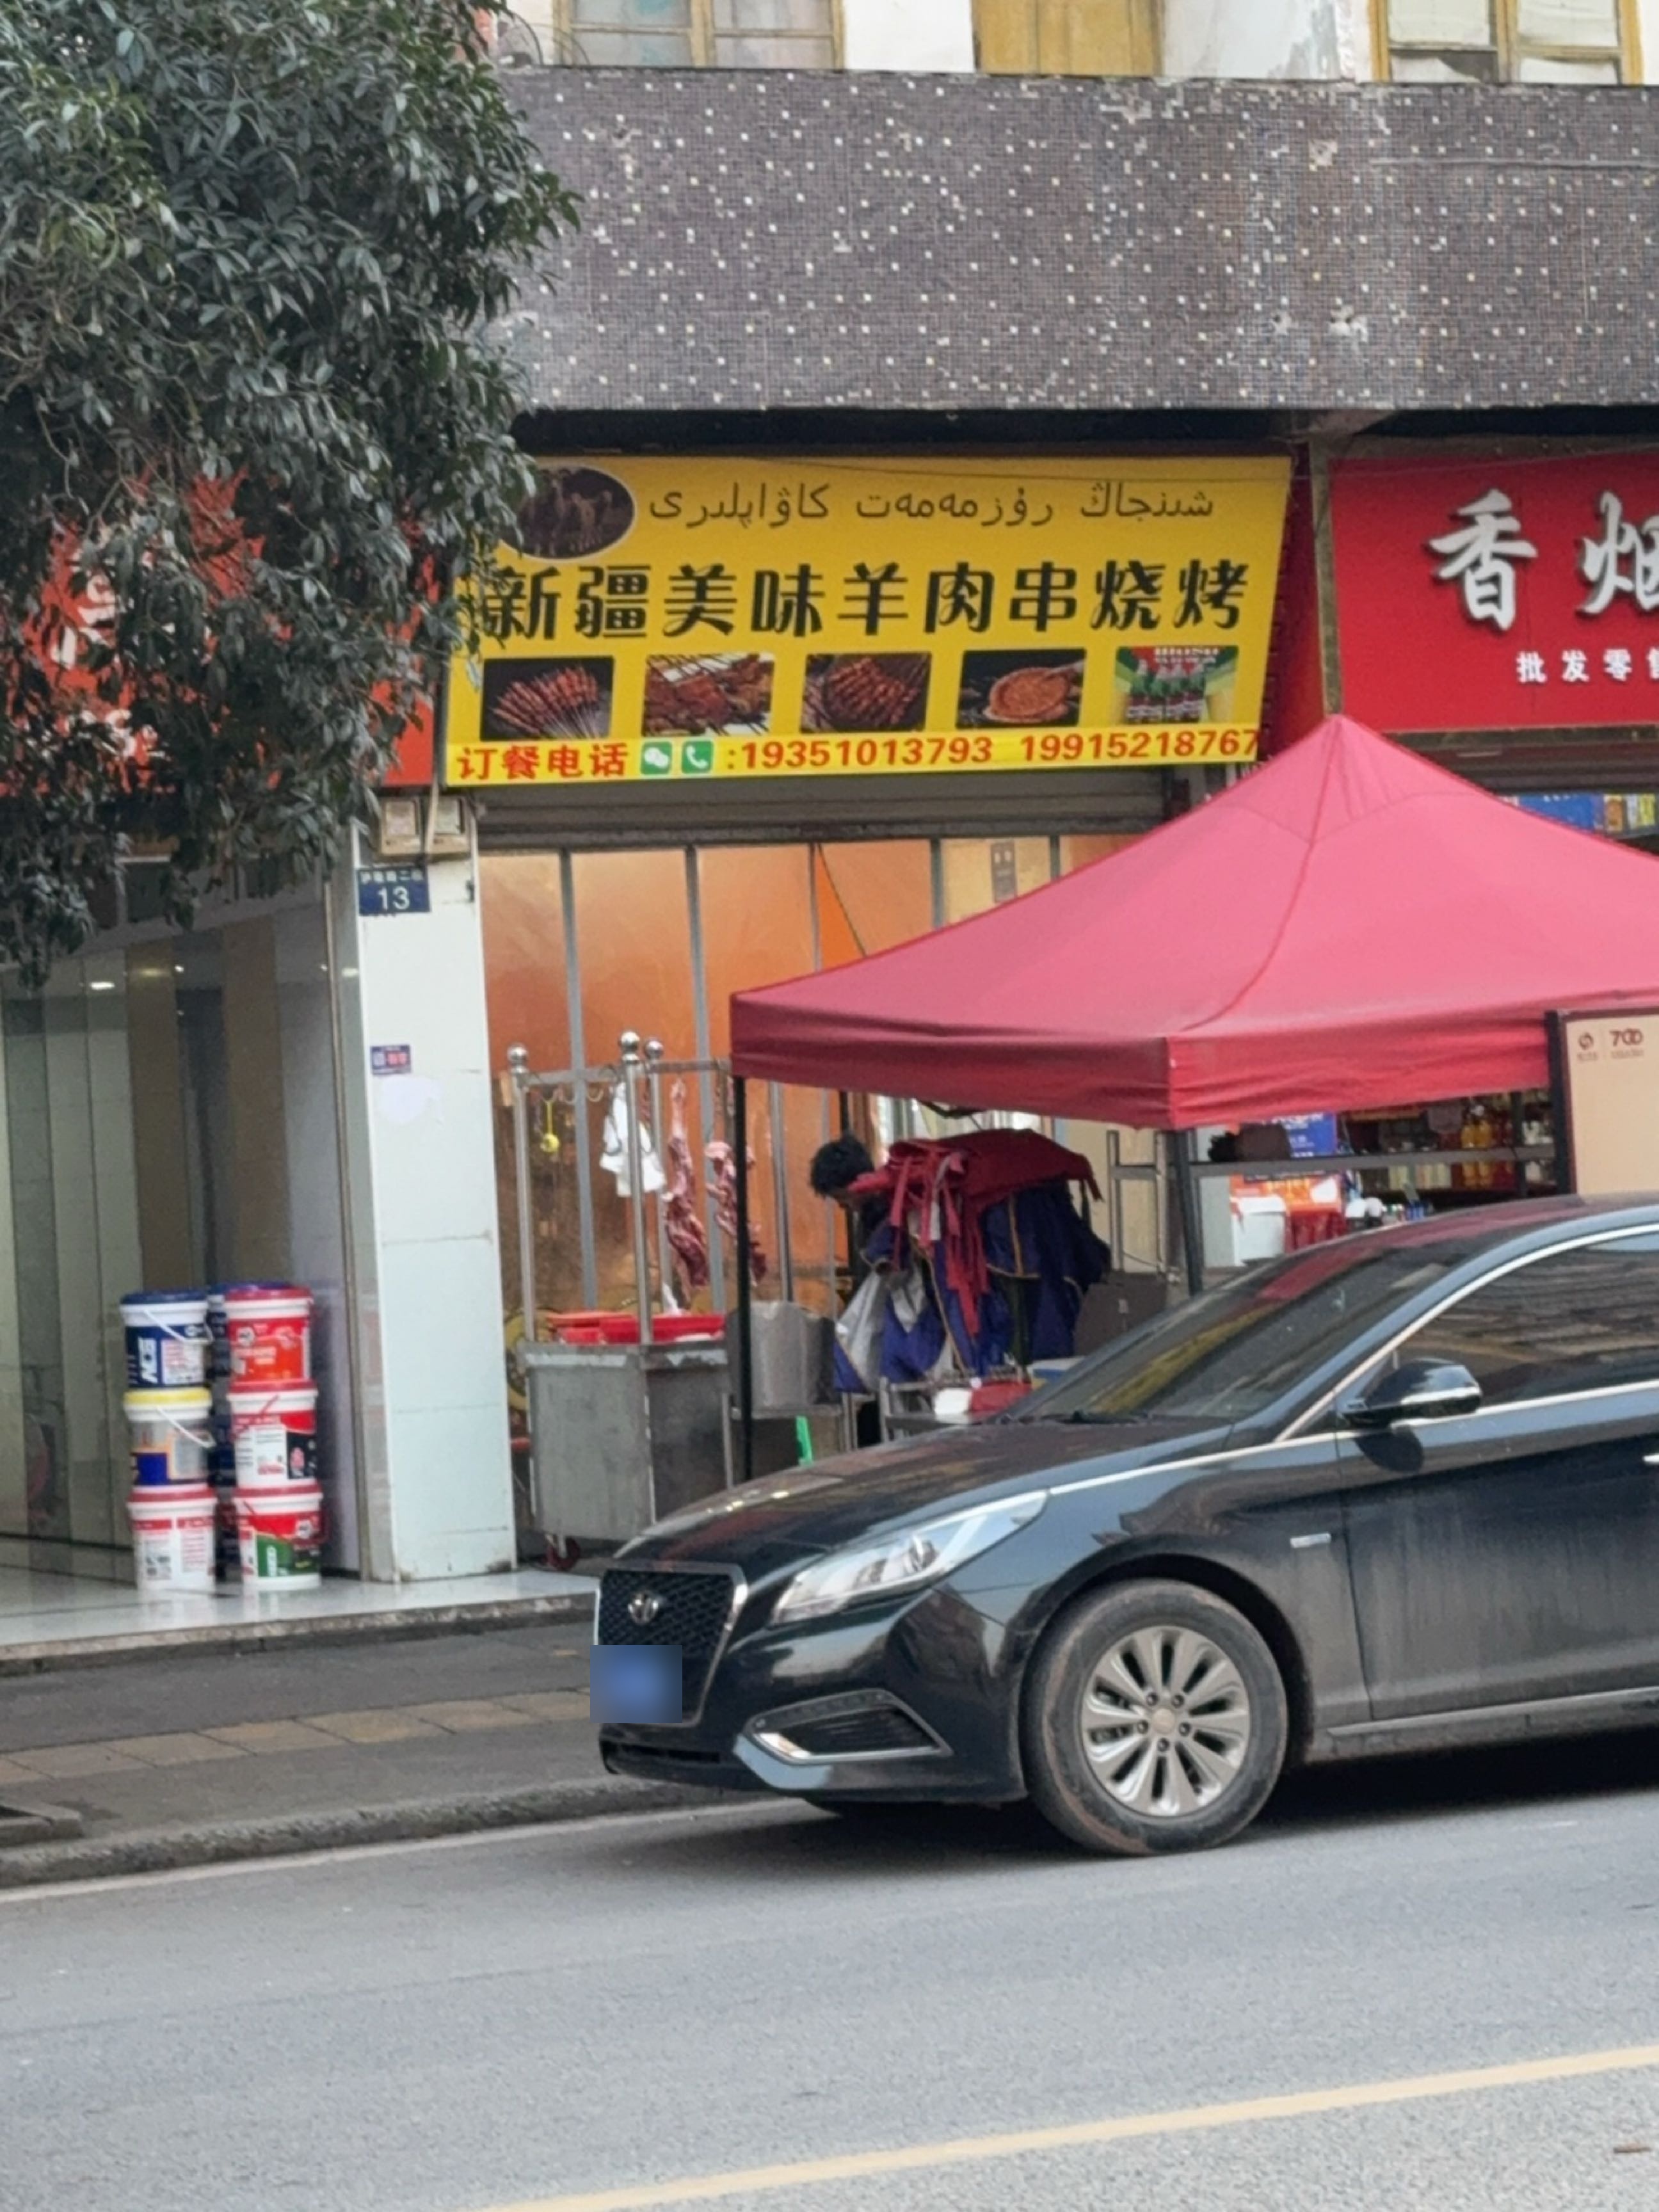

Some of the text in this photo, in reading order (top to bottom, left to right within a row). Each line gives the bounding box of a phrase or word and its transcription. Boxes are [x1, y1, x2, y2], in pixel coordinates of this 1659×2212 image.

[481, 558, 1249, 641] 新疆美味羊肉串烧烤
[456, 742, 628, 780] 订餐电话
[1021, 728, 1261, 762] 19915218767
[378, 885, 410, 911] 13
